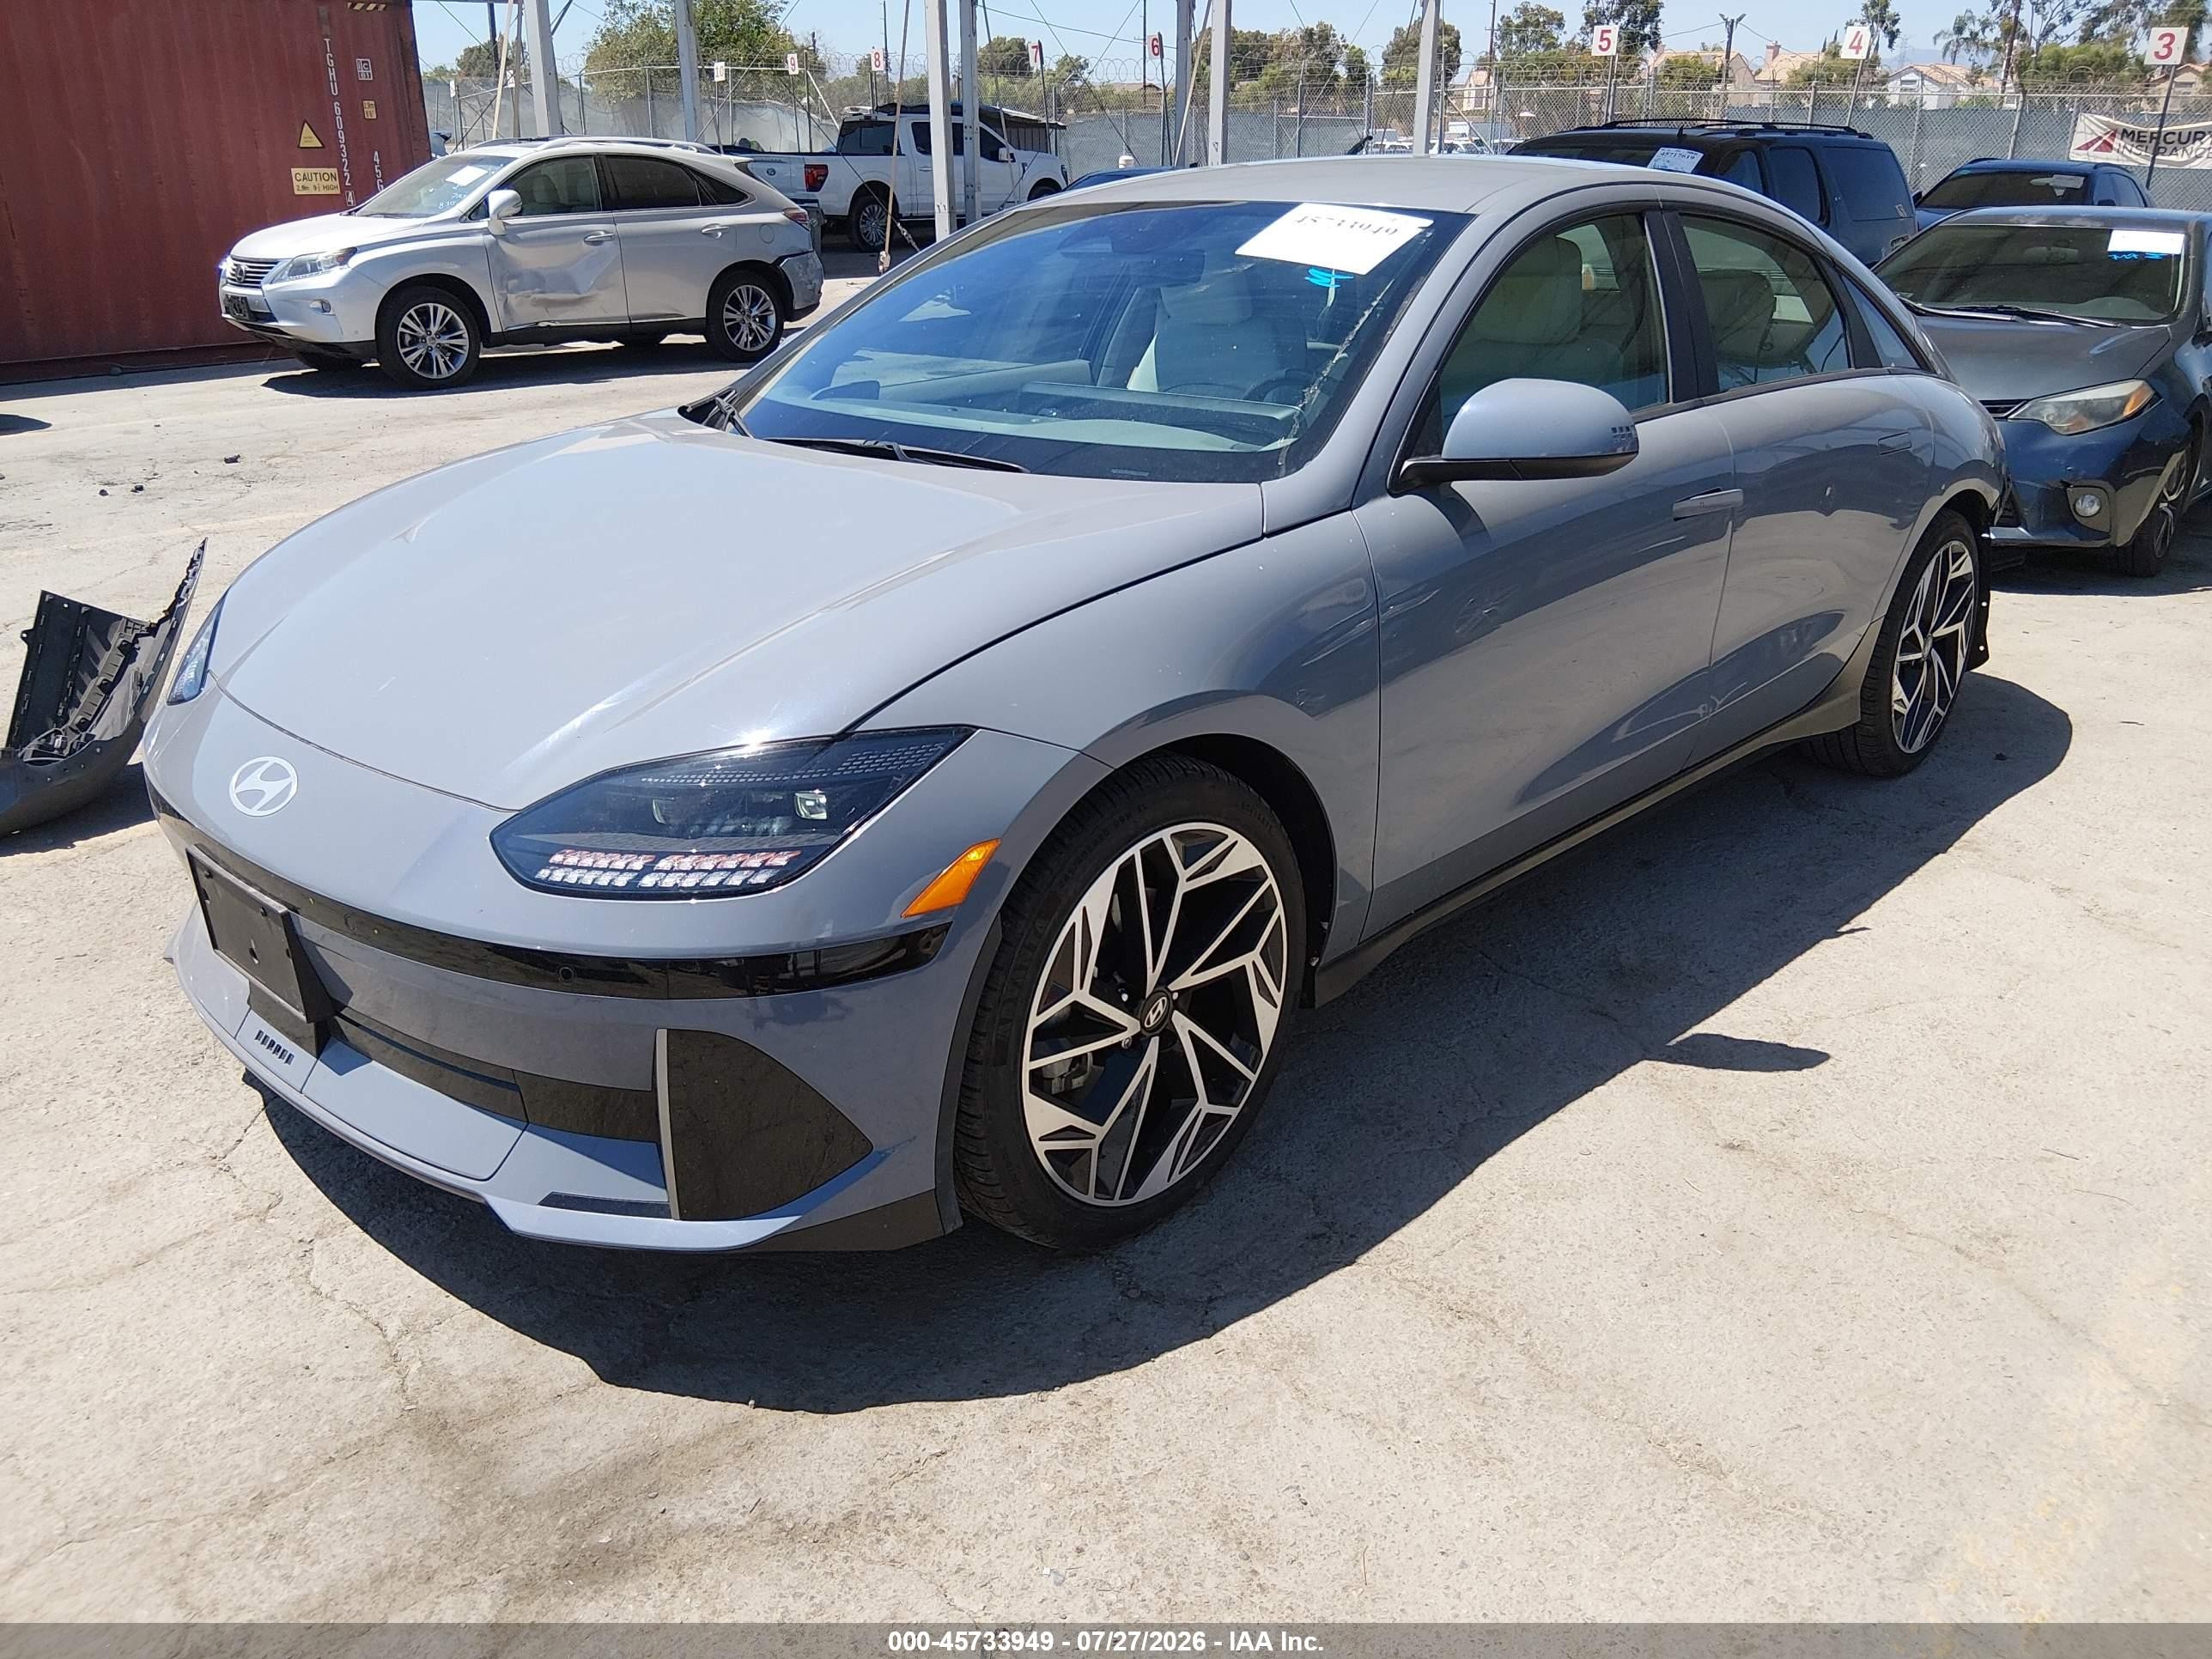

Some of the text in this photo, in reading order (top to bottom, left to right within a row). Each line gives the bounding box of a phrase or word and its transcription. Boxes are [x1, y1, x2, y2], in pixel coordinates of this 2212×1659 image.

[1151, 37, 1160, 57] 6
[1598, 29, 1612, 52] 5
[1848, 30, 1863, 55] 4
[2154, 33, 2176, 60] 3
[873, 52, 881, 68] 8
[1031, 45, 1040, 64] 7
[715, 65, 724, 77] 10
[790, 57, 796, 72] 9
[324, 38, 338, 95] TGHU
[333, 101, 351, 186] 609322
[295, 172, 337, 182] CAUTION
